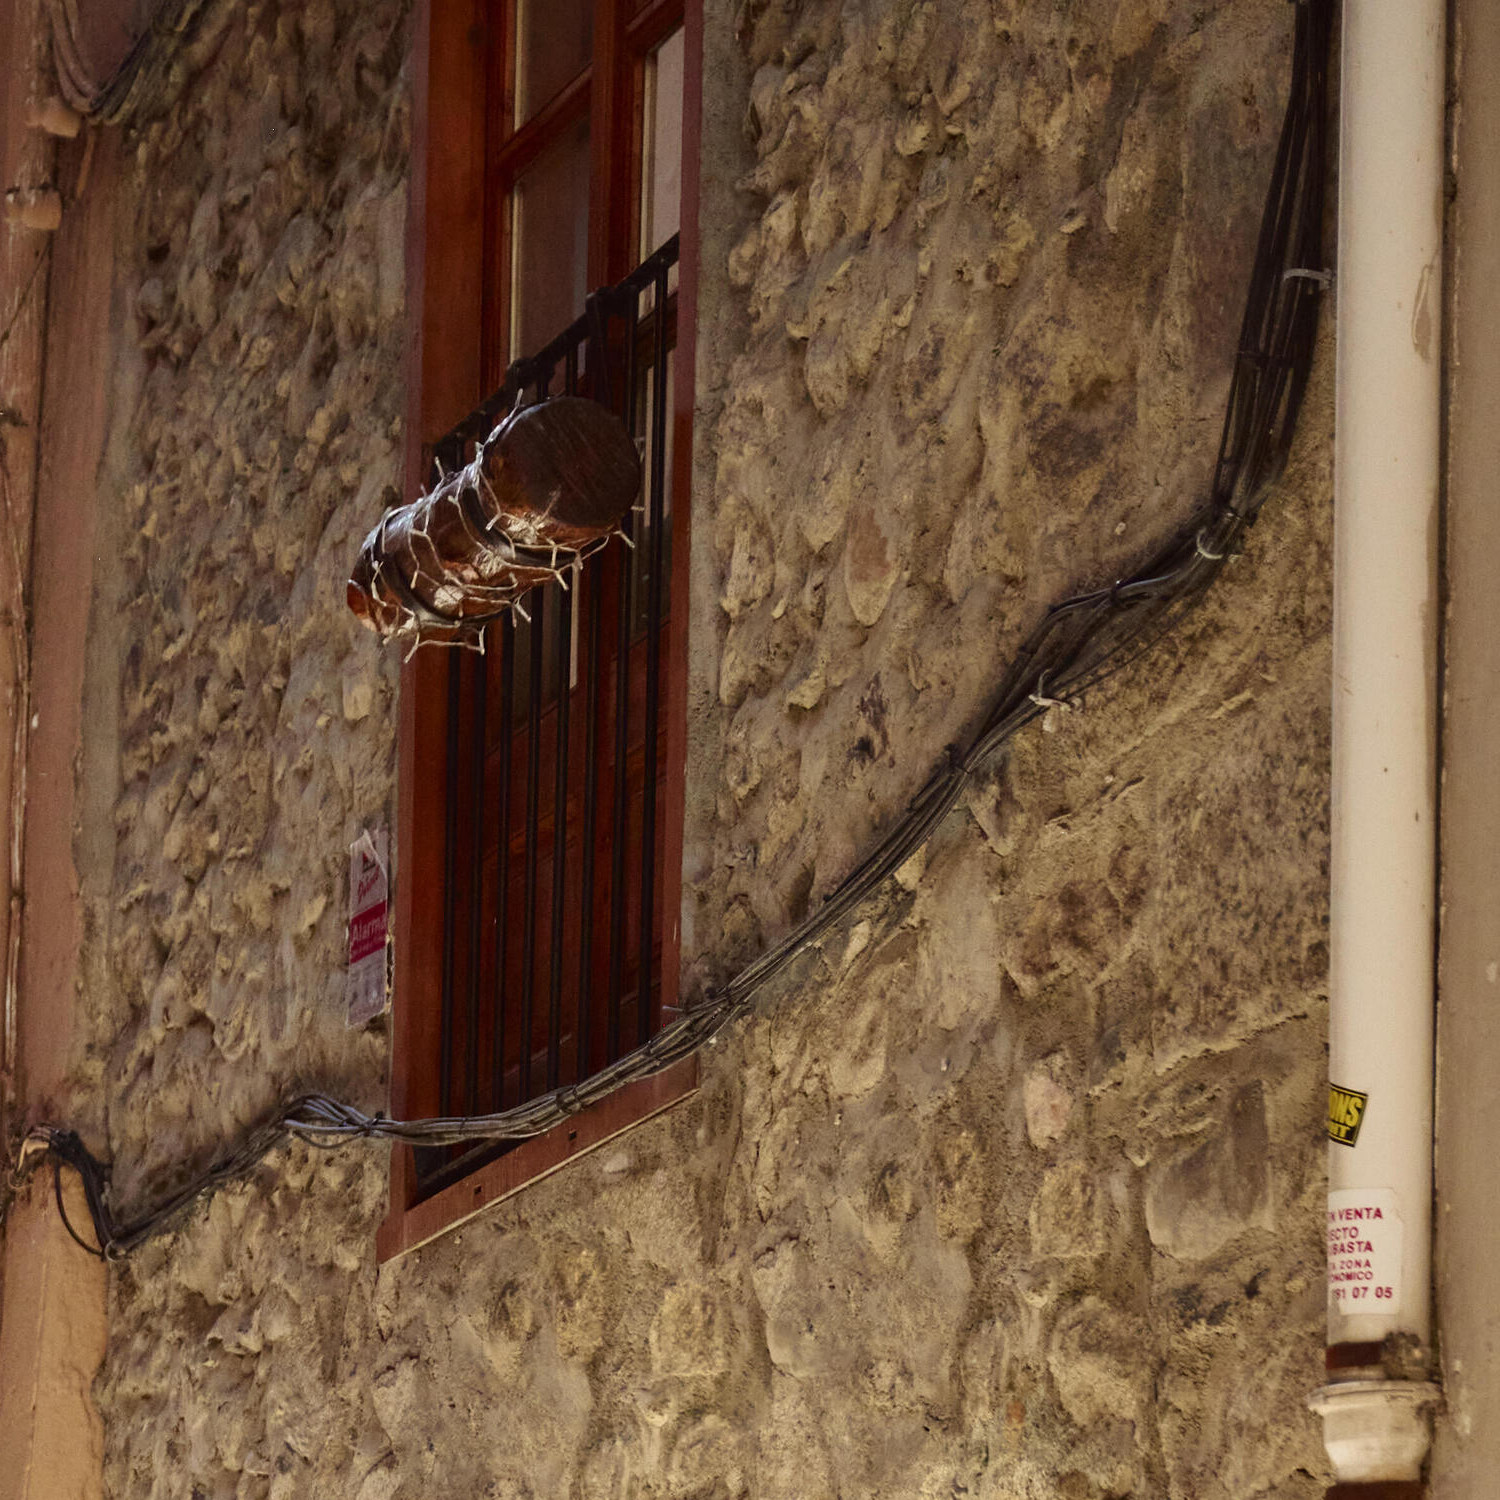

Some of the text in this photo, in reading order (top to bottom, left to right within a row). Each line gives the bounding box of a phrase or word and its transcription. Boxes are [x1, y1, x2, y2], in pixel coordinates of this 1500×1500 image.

[1338, 1207, 1383, 1220] VENTA
[1340, 1259, 1372, 1270] ZONA
[1352, 1286, 1368, 1299] 07
[1375, 1286, 1393, 1299] 05
